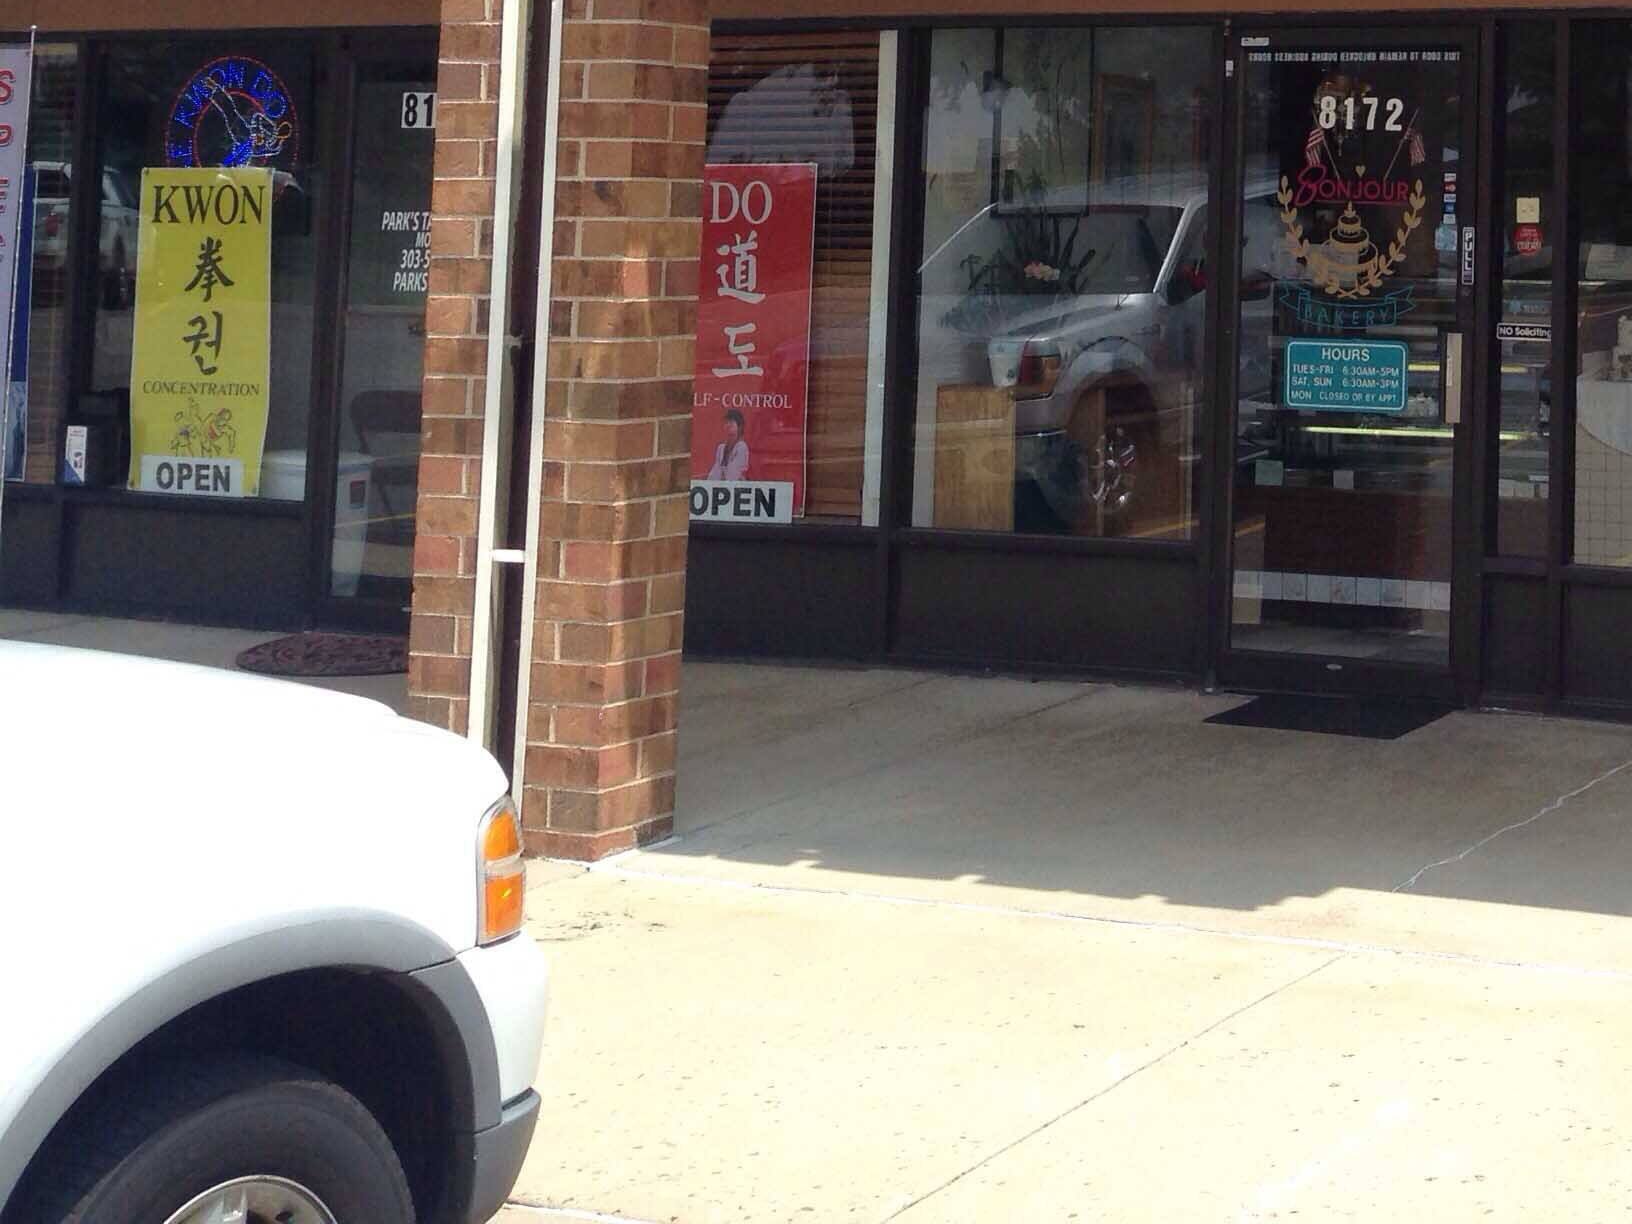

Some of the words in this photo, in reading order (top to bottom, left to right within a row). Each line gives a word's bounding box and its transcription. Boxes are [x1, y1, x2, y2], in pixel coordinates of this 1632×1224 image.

[404, 94, 434, 127] 81
[1319, 95, 1404, 131] 8172
[152, 184, 265, 225] KWON
[709, 180, 772, 225] DO
[381, 212, 419, 231] PARK'S
[415, 233, 431, 248] MO
[400, 249, 431, 269] 303-5
[1464, 232, 1473, 271] PULL
[184, 236, 234, 303] 拳
[716, 230, 766, 305] 道
[393, 272, 427, 291] PARKS
[1304, 303, 1389, 325] BAKERY
[1500, 326, 1513, 336] NO
[1515, 326, 1552, 338] Soliciting
[182, 311, 223, 375] 권
[1322, 347, 1370, 362] HOURS
[1292, 363, 1334, 374] TUES-FRI
[142, 380, 260, 397] CONCENTRATION
[1313, 377, 1332, 387] SUN
[694, 392, 792, 409] LF-CONTROL
[1291, 390, 1312, 400] MON
[1319, 392, 1350, 401] CLOSED
[155, 462, 231, 493] OPEN
[689, 486, 776, 518] OPEN
